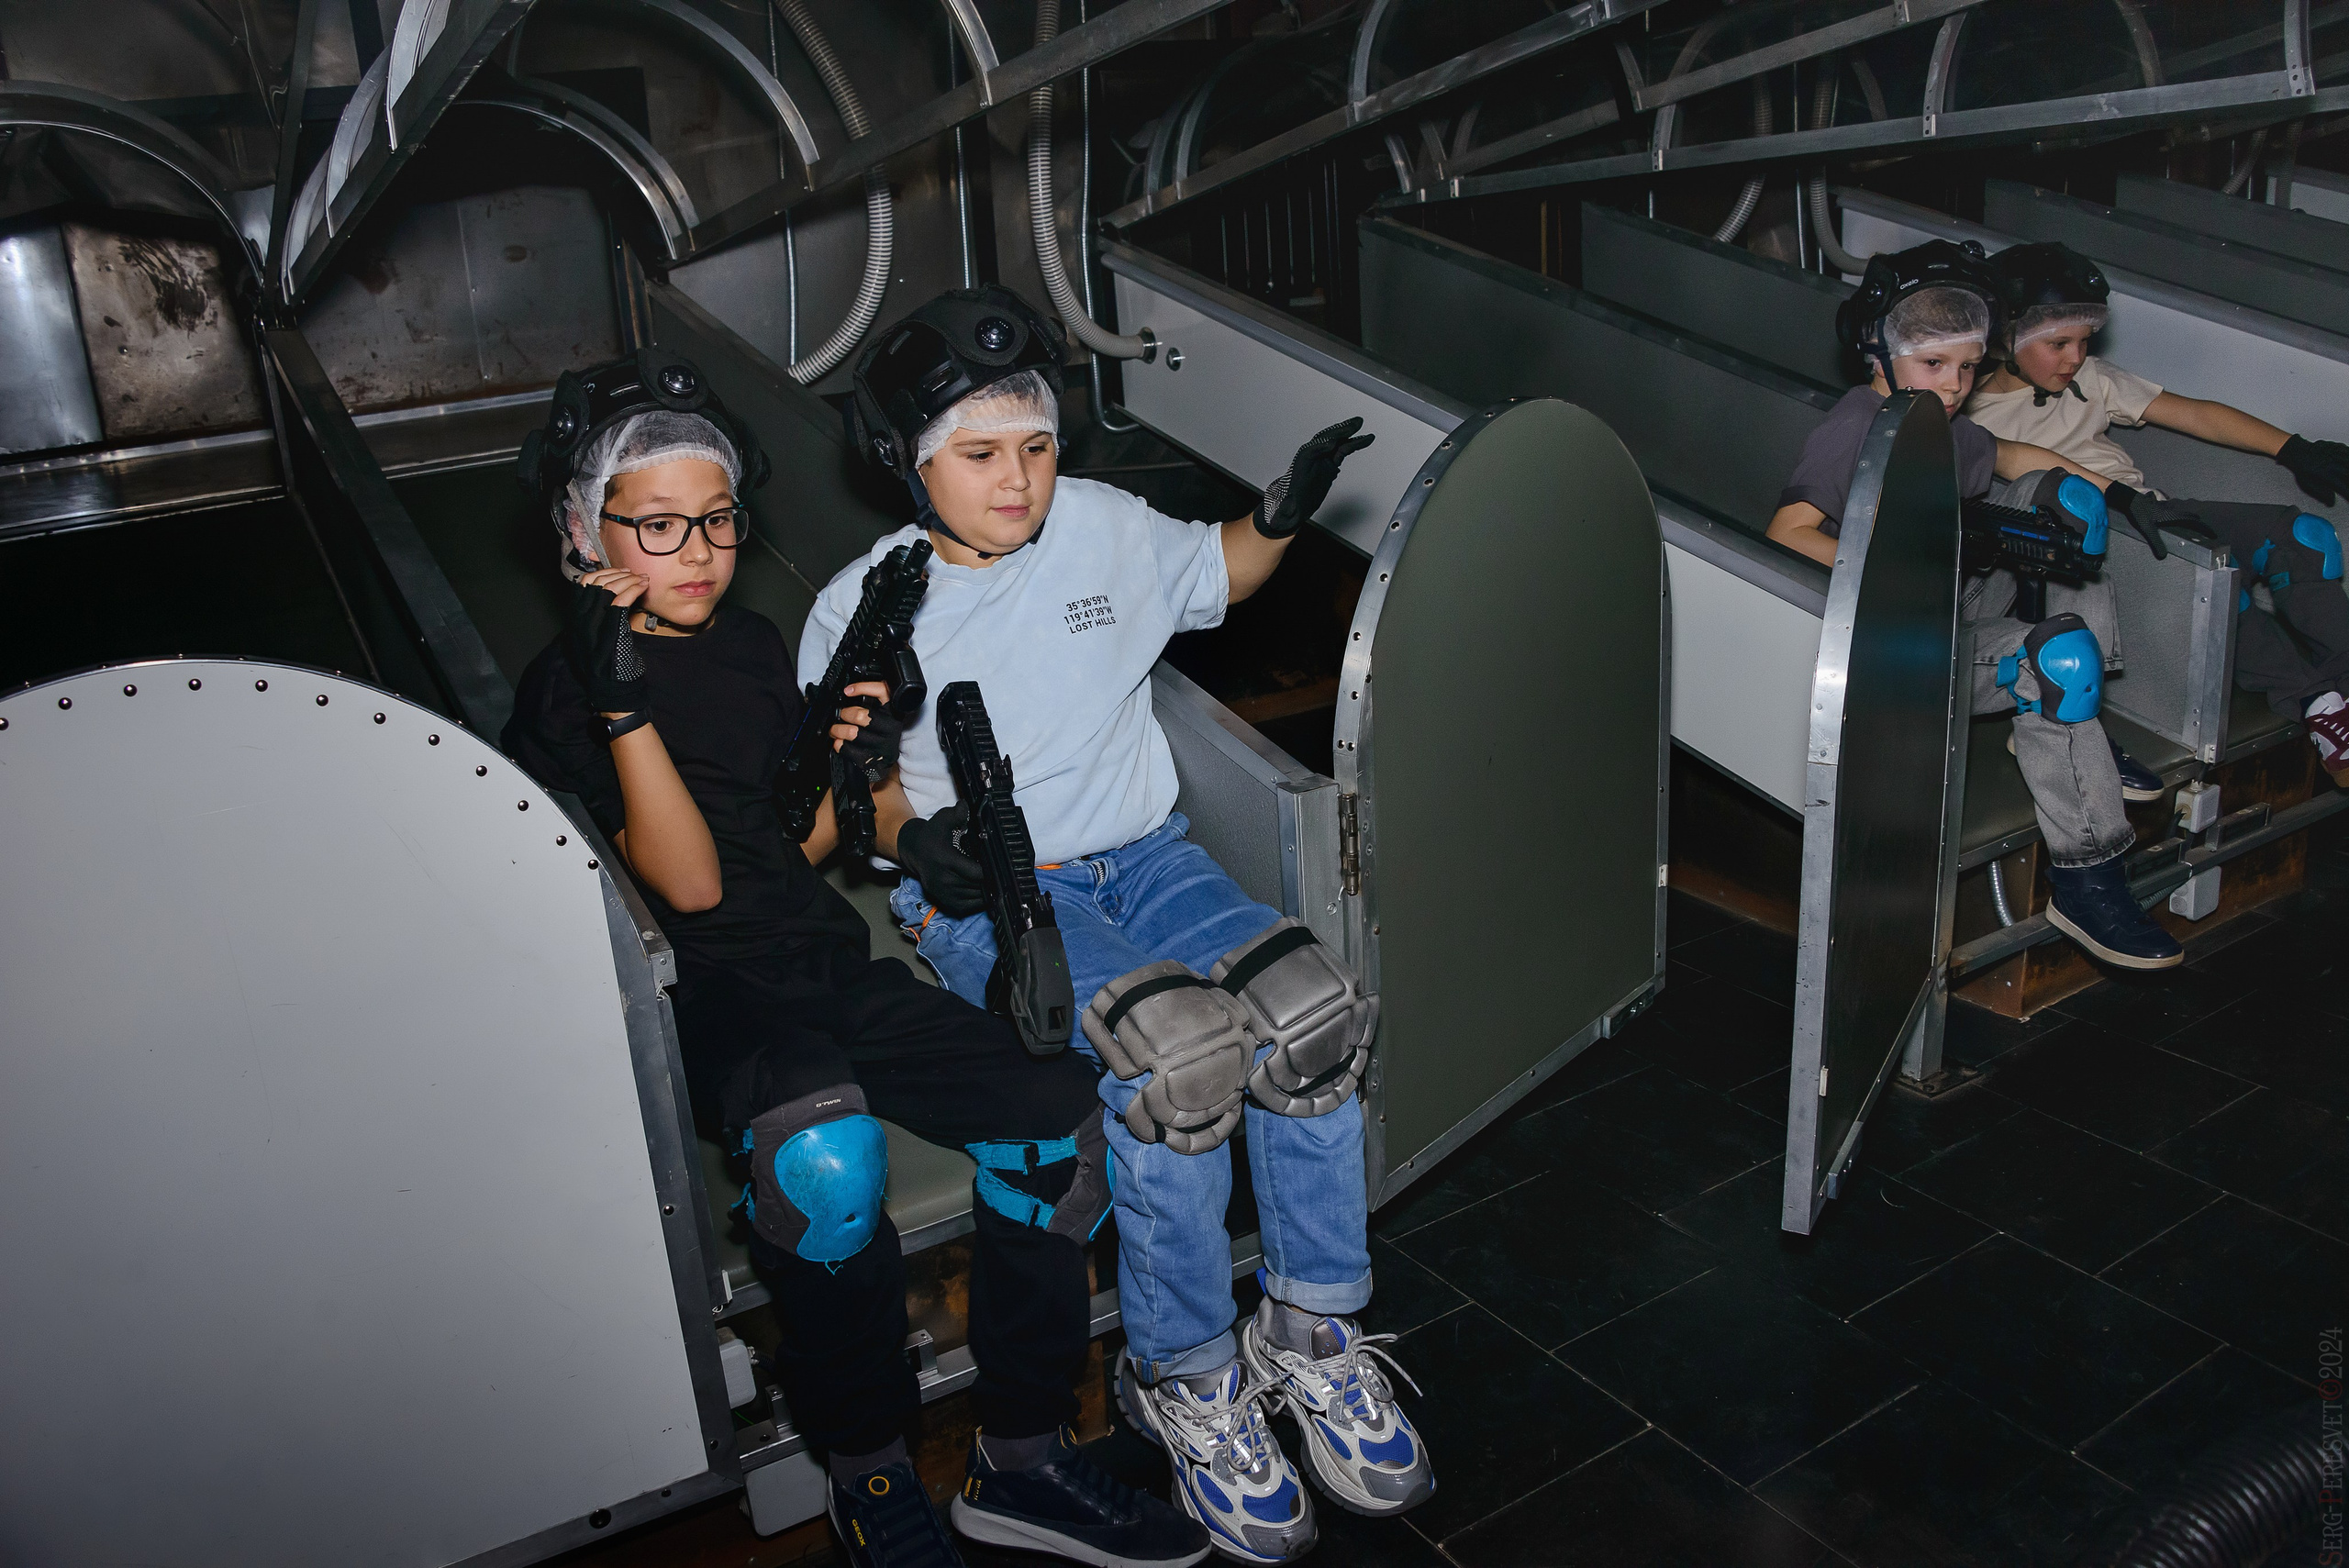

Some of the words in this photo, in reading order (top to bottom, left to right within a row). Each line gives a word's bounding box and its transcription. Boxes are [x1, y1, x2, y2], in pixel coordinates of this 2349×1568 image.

[1899, 278, 1920, 290] oxelo
[1069, 620, 1093, 635] LOST
[1095, 616, 1117, 628] HILLS
[852, 1518, 866, 1547] GEOX
